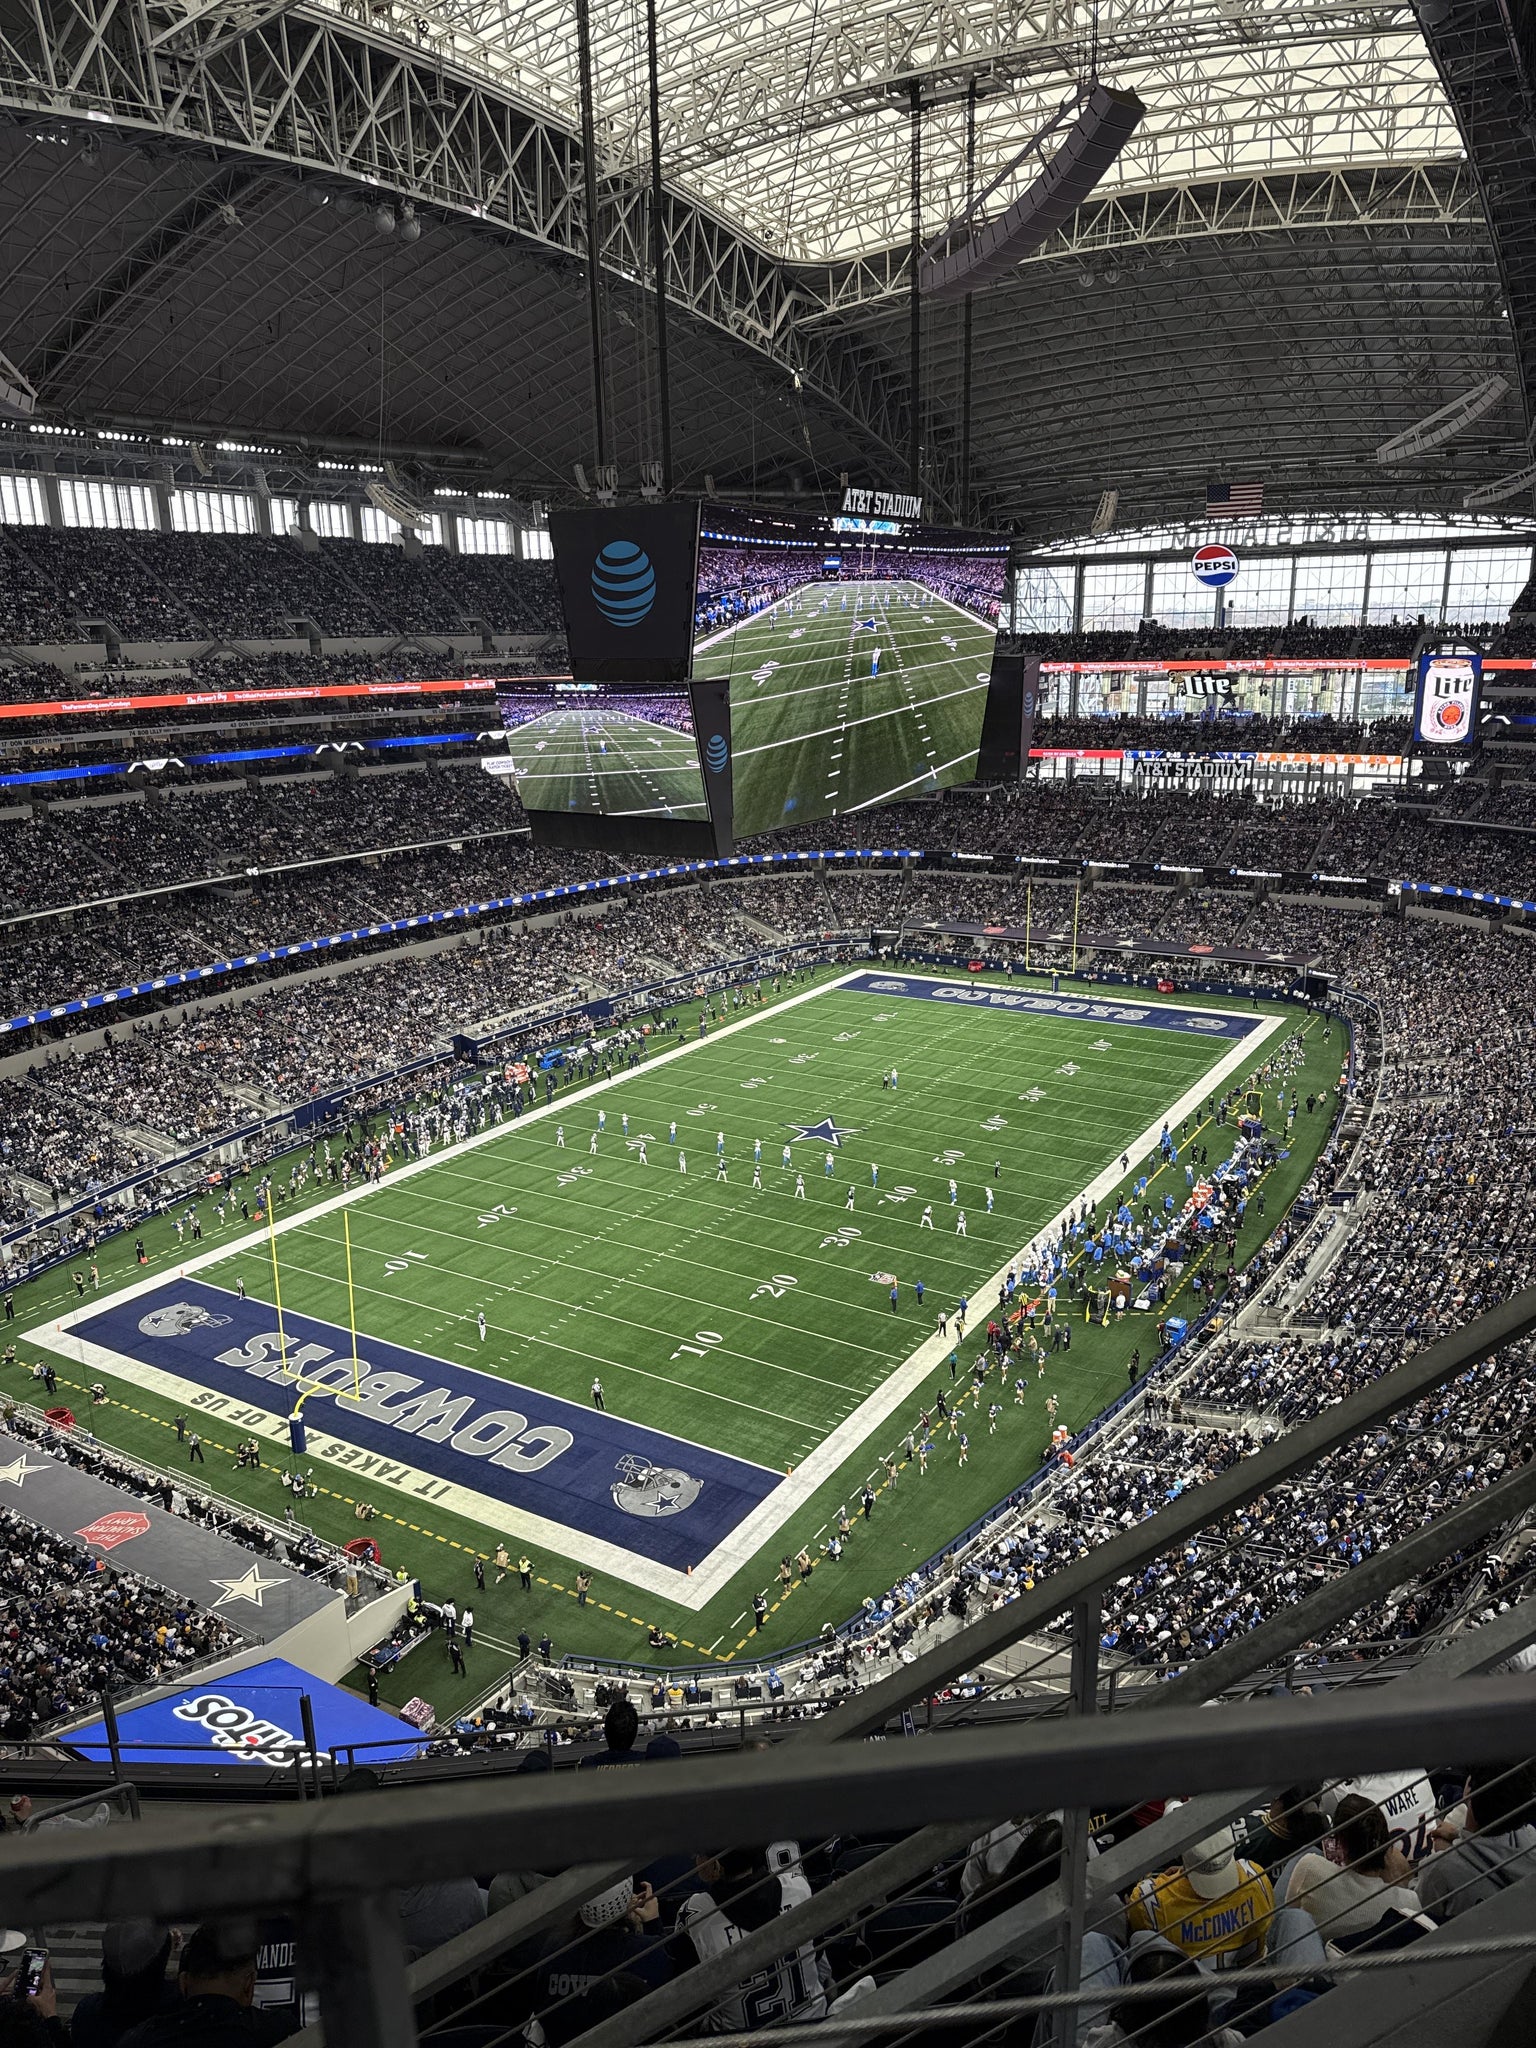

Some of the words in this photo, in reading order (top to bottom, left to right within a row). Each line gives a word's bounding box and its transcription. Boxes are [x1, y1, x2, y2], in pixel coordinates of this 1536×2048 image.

[842, 487, 874, 514] AT&T
[874, 491, 923, 519] STADIUM
[1194, 561, 1236, 572] PEPSI
[1184, 676, 1231, 699] Lite
[1434, 677, 1472, 699] Lite
[1134, 761, 1172, 776] AT&T
[1175, 762, 1247, 778] STADIUM
[931, 987, 1151, 1021] COWBOYS
[556, 1166, 594, 1183] 30
[884, 1186, 917, 1203] 40
[477, 1204, 518, 1224] 20
[823, 1227, 862, 1247] 30
[384, 1250, 430, 1271] 10
[756, 1274, 799, 1299] 20
[678, 1331, 724, 1357] 10
[190, 1391, 230, 1411] US
[213, 1332, 574, 1473] COWBOYS
[228, 1409, 271, 1426] OF
[320, 1443, 414, 1485] TAKES
[413, 1484, 453, 1500] IT
[1385, 1785, 1420, 1817] WARE
[1181, 1896, 1255, 1944] McCONKEY
